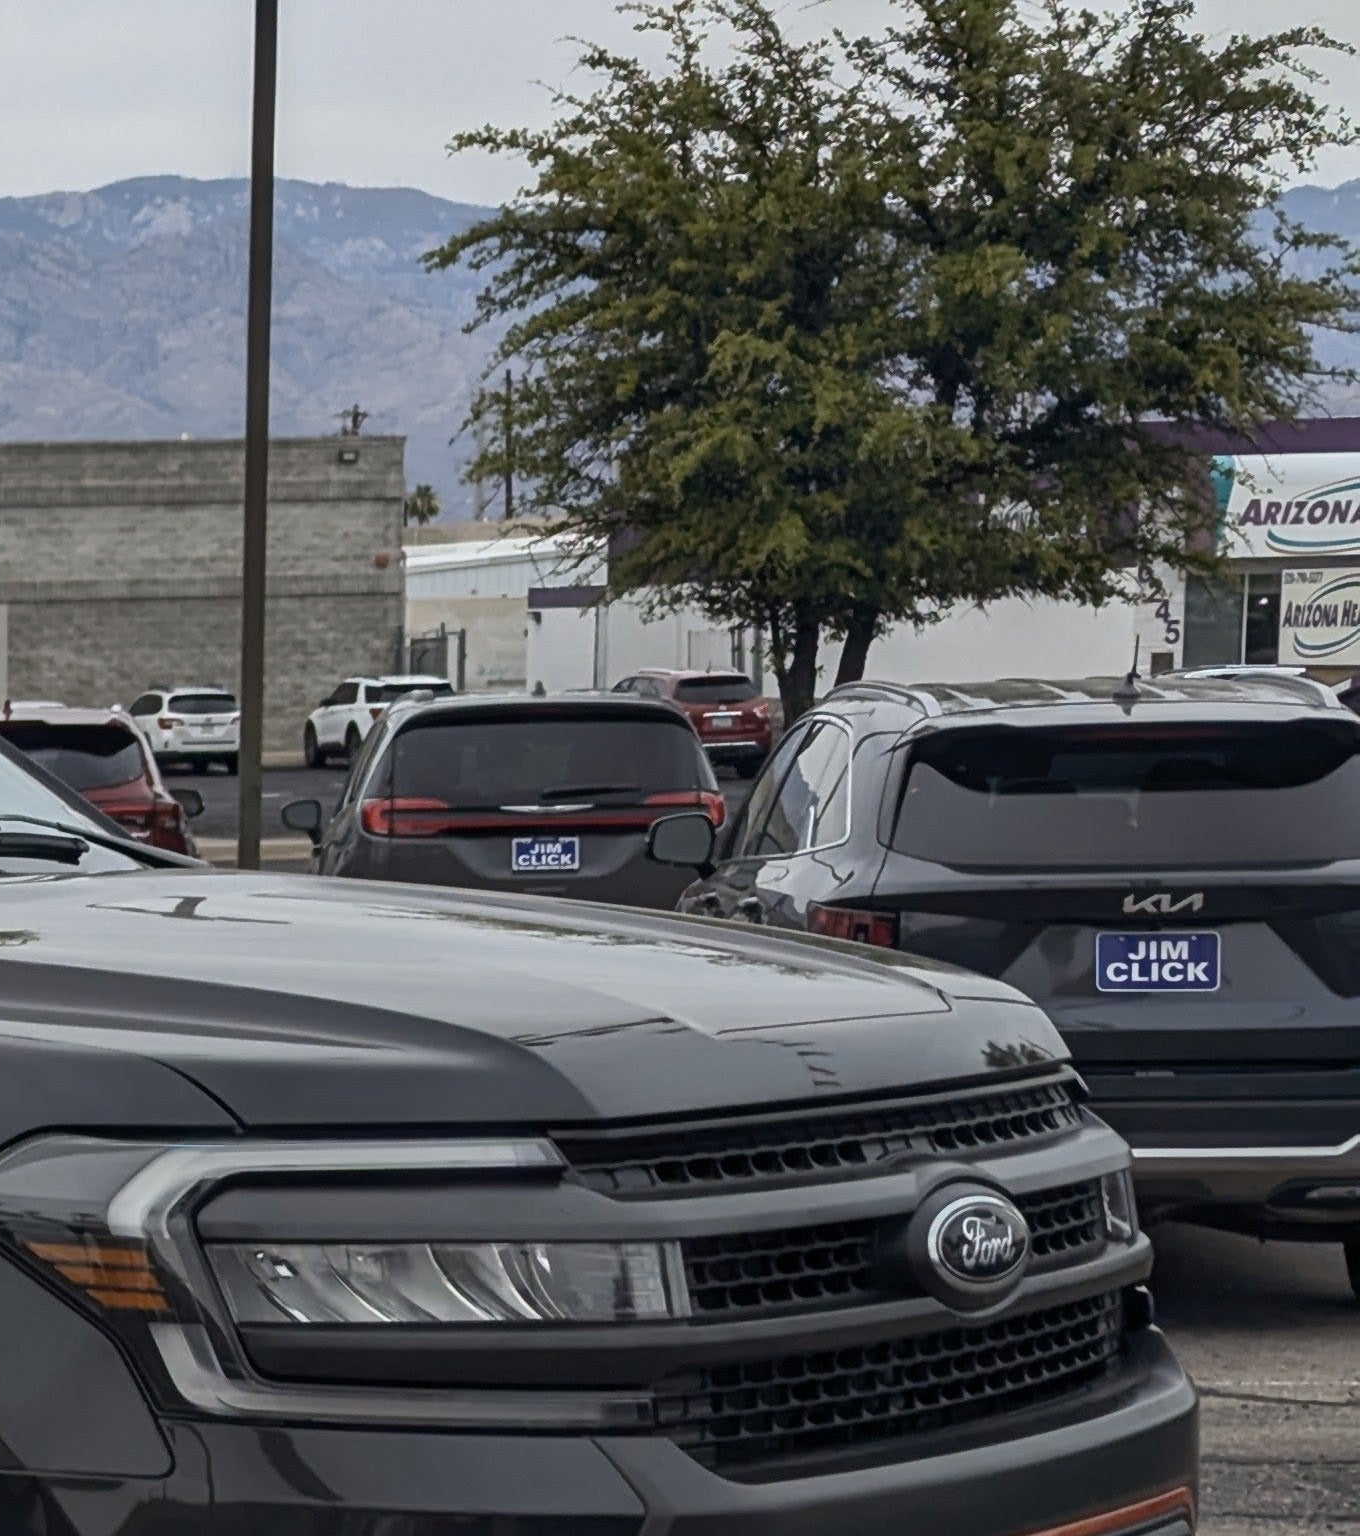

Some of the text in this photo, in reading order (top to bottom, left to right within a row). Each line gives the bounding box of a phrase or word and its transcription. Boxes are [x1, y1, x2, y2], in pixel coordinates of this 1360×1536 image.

[1283, 600, 1338, 628] ARIZONA
[529, 842, 562, 855] JIM
[518, 854, 572, 866] CLICK
[1128, 941, 1189, 961] JIM
[1106, 961, 1210, 982] CLICK
[962, 1216, 1015, 1268] Ford
